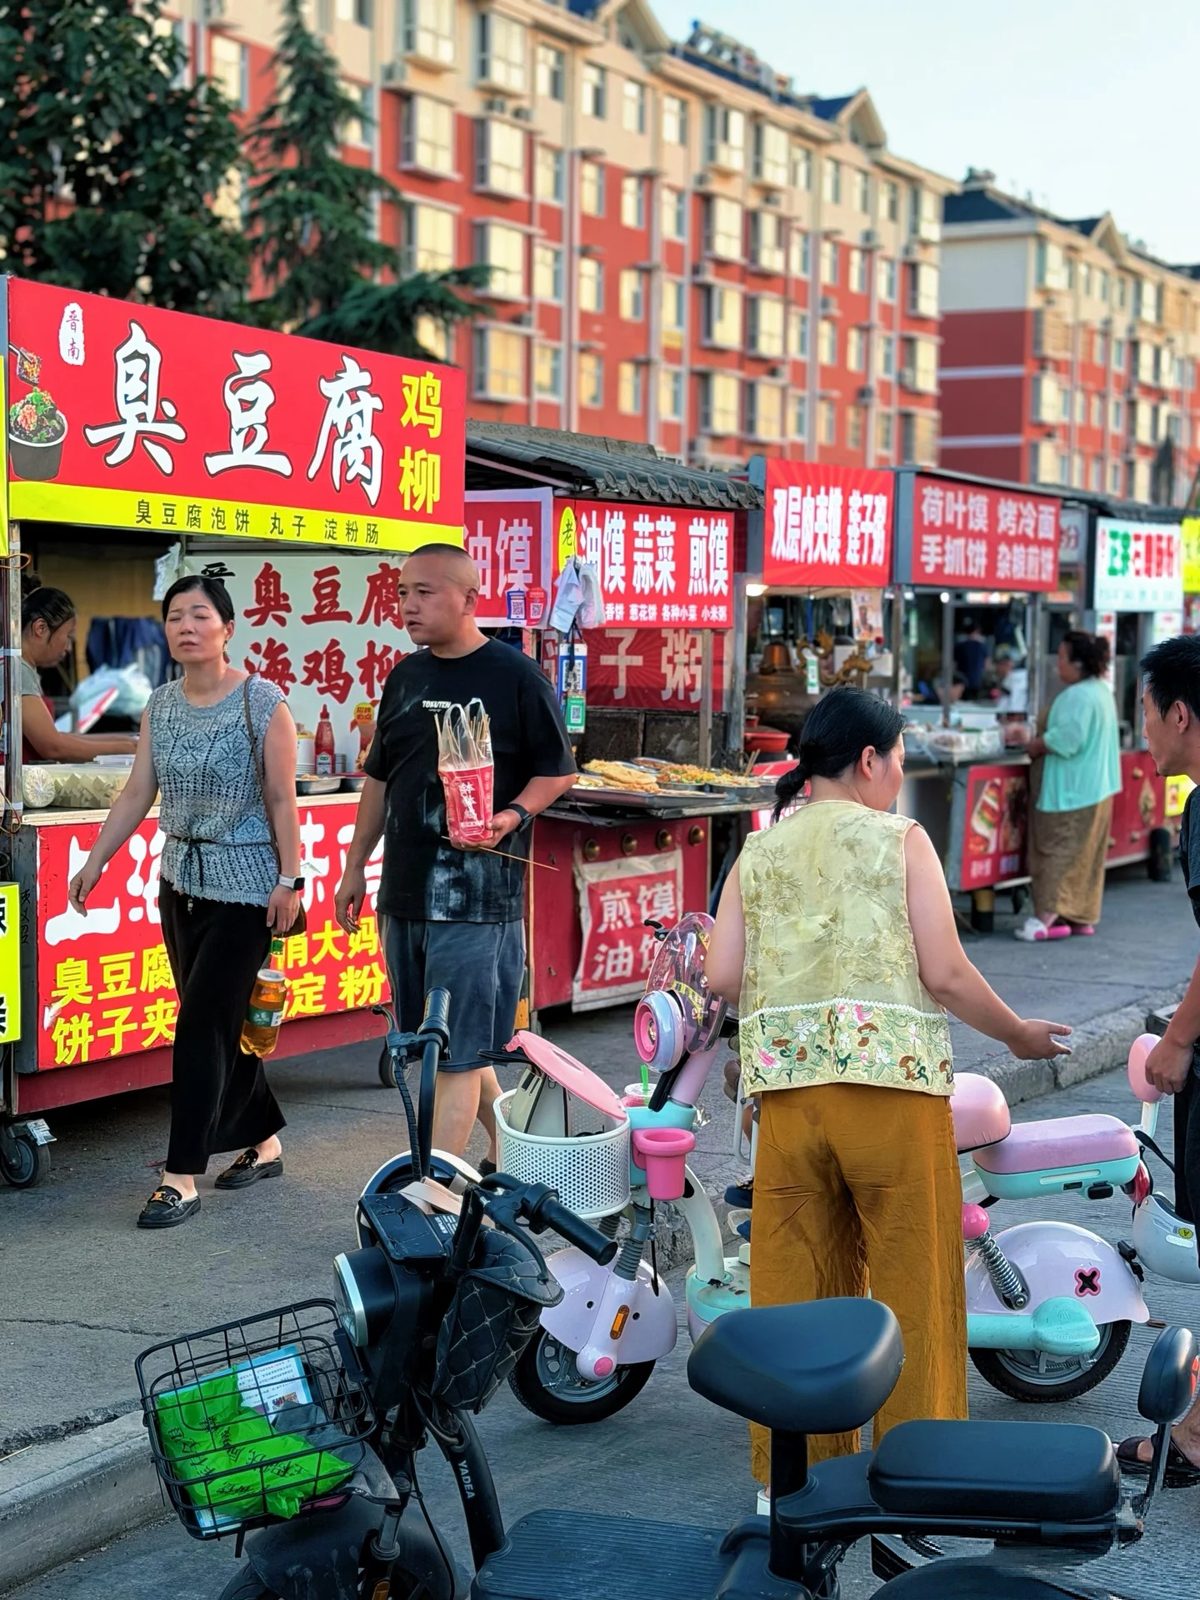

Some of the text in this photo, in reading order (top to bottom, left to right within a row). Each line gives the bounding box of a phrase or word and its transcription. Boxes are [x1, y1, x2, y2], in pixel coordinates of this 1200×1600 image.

[66, 309, 80, 361] 晋南
[84, 320, 384, 507] 臭豆腐
[398, 370, 444, 515] 鸡柳
[134, 499, 380, 545] 臭豆腐泡饼 丸子 淀粉肠
[562, 518, 574, 559] 老
[920, 485, 1057, 541] 荷叶馍 烤冷面
[580, 509, 729, 597] 油馍 蒜菜 煎馍
[920, 533, 988, 579] 手抓饼
[243, 561, 405, 628] 臭豆腐
[225, 637, 409, 705] 海鸡柳
[597, 881, 676, 933] 煎馍
[51, 943, 176, 1009] 臭豆腐
[458, 1459, 476, 1500] YADEA
